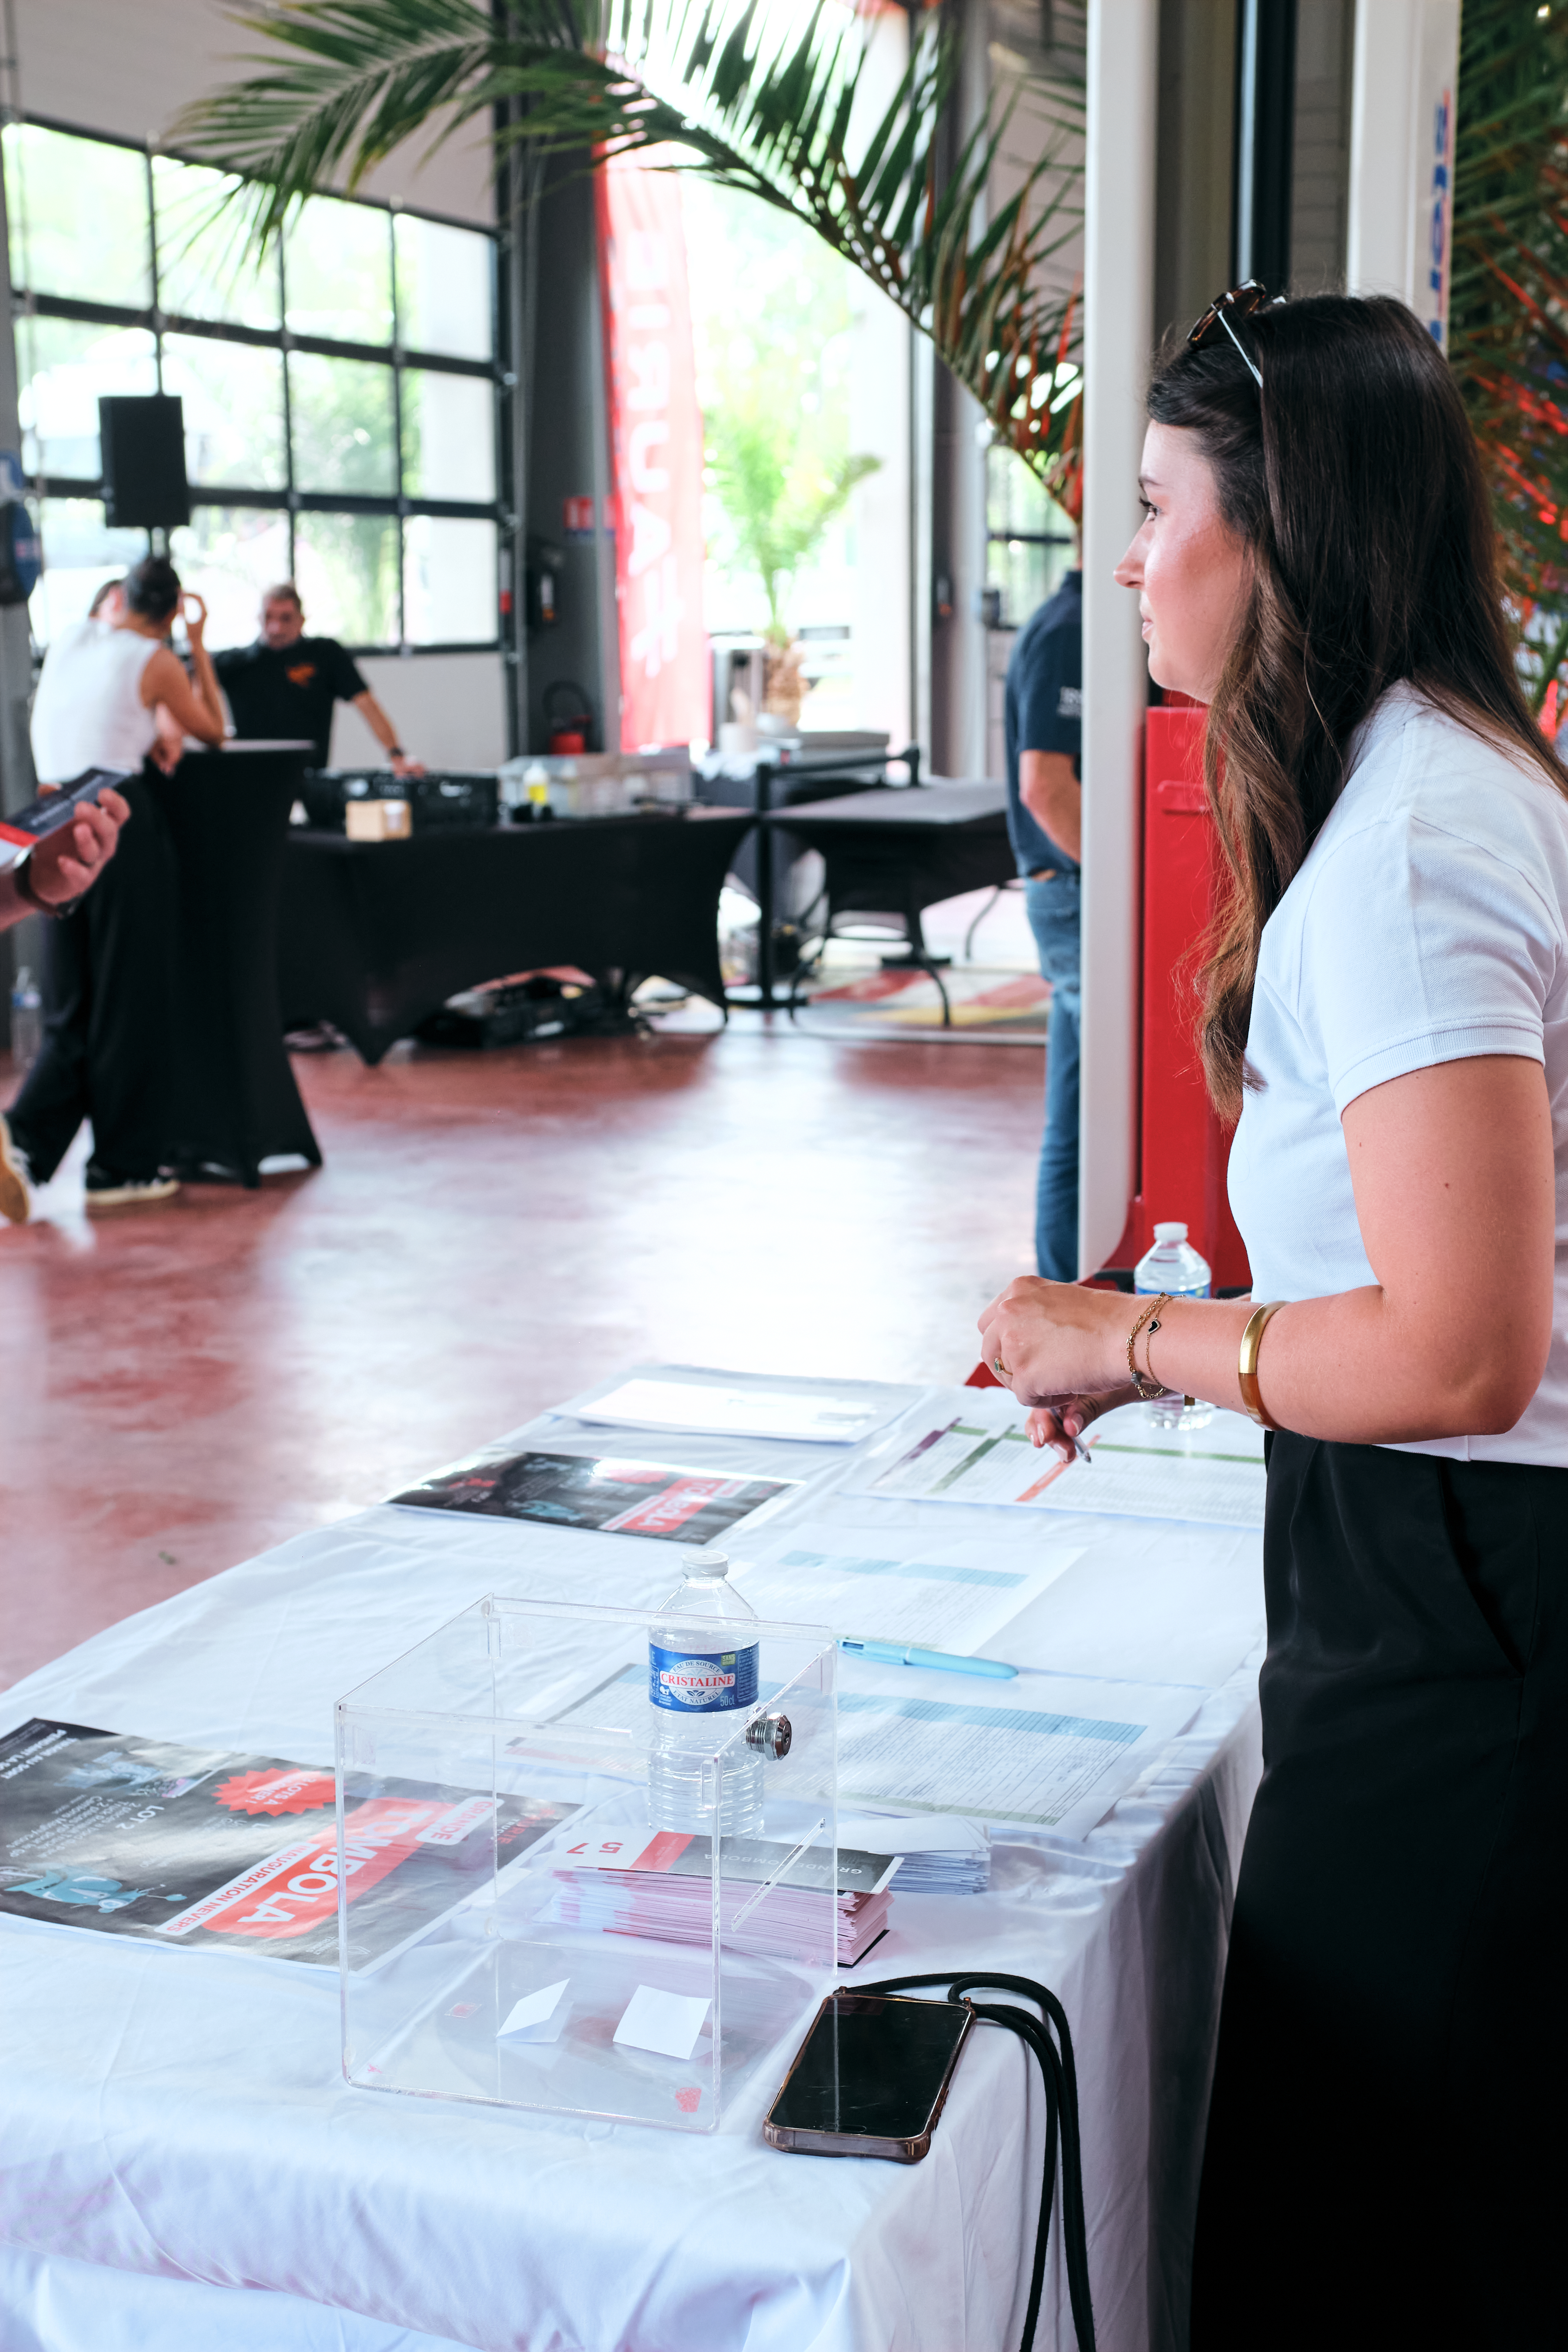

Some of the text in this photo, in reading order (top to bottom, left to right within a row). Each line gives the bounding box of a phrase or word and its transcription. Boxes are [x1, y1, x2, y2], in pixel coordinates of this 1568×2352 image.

[673, 1664, 684, 1672] EAU
[696, 1661, 721, 1674] SOURCE
[661, 1674, 733, 1687] CRISTALINE
[673, 1690, 688, 1701] ETAT
[689, 1692, 721, 1704] NATUREL
[720, 1695, 735, 1707] 50cl
[271, 1782, 309, 1800] LOTS
[128, 1805, 166, 1823] LOT
[429, 1801, 496, 1840] GRANDE
[487, 1819, 521, 1840] TRUC
[235, 1809, 436, 1922] TOMBOLA
[704, 1854, 862, 1874] GRNDE OMBOLA
[164, 1845, 310, 1932] INAUGURATION NEVERS
